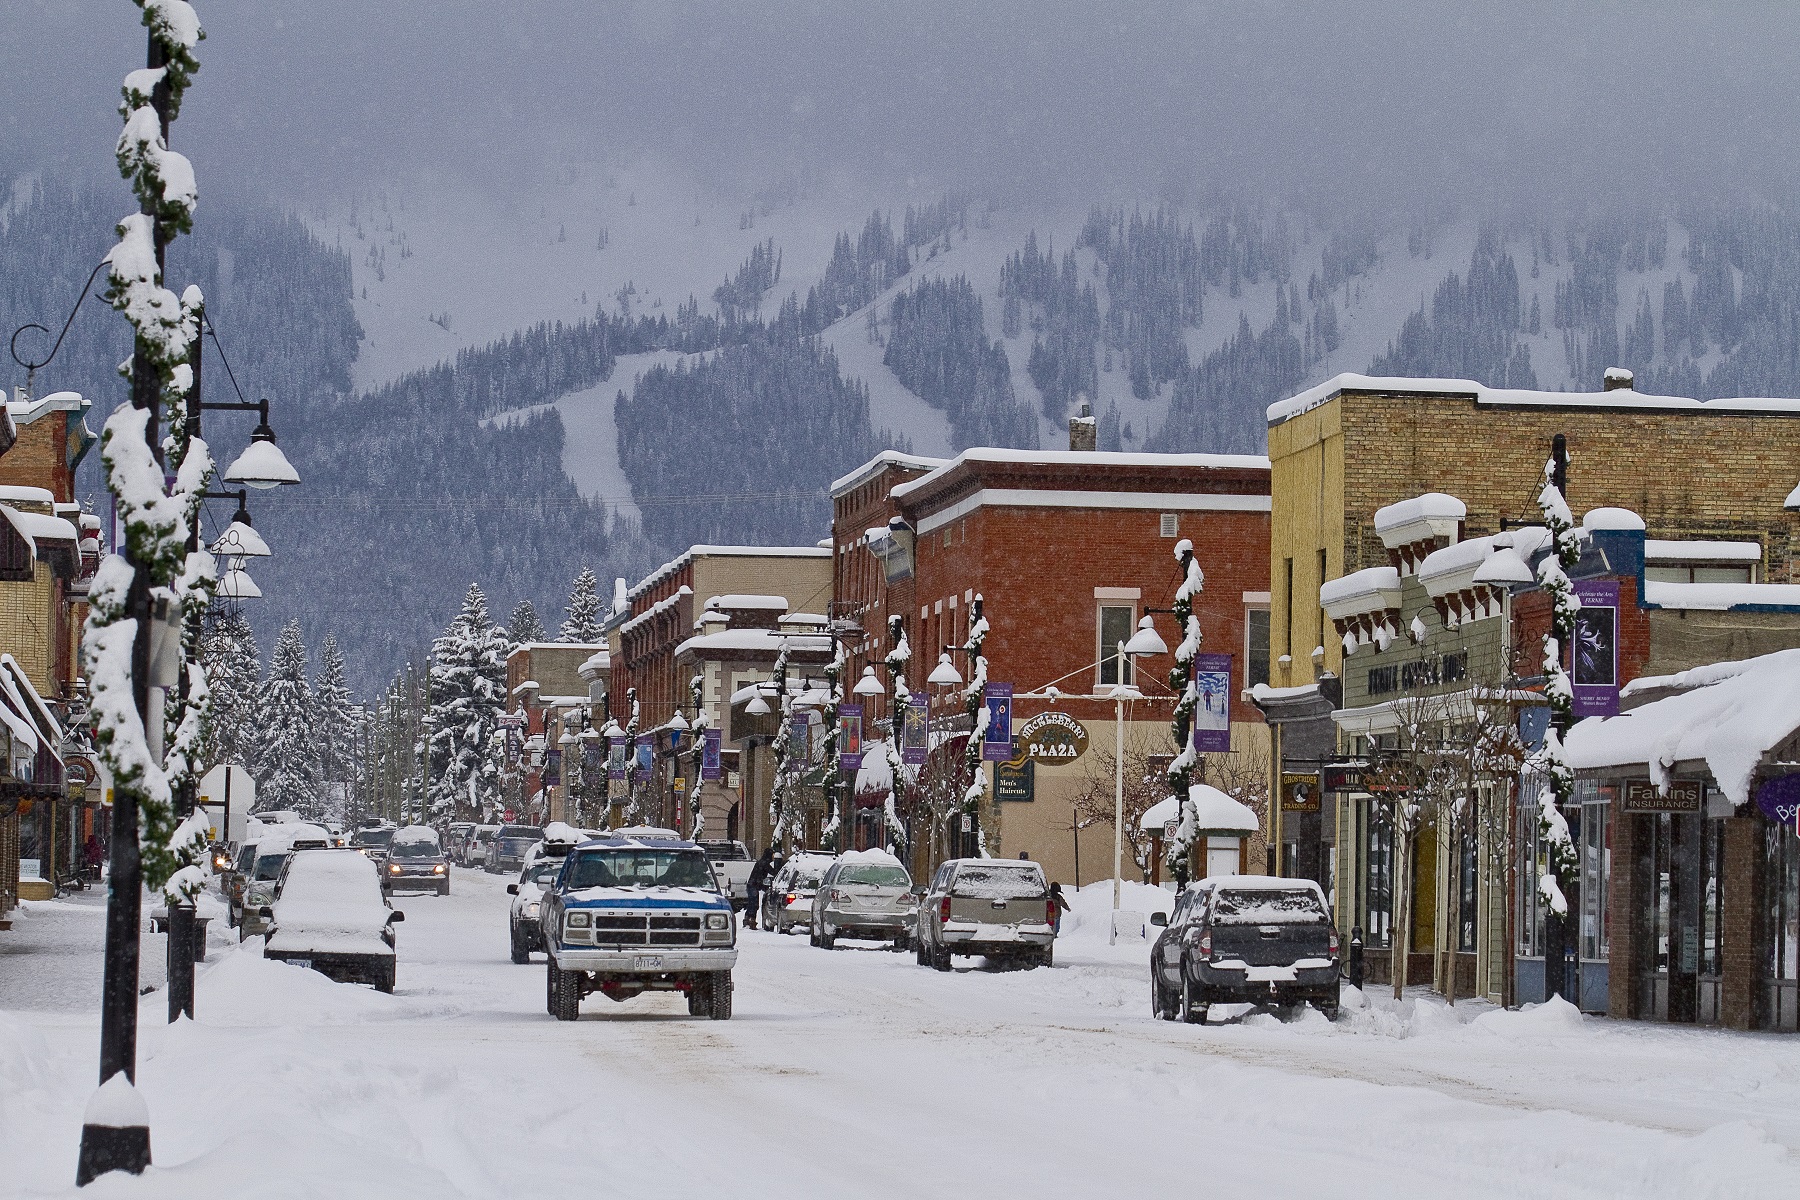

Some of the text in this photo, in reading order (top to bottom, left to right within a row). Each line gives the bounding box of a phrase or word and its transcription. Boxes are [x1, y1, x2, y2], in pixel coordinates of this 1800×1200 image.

[1022, 714, 1086, 740] HUCKLEBERRY
[1029, 742, 1078, 757] PLAZA
[1283, 775, 1318, 785] GHOSTRIDER
[1283, 802, 1307, 810] TRADING
[1629, 800, 1697, 809] INSURANCE
